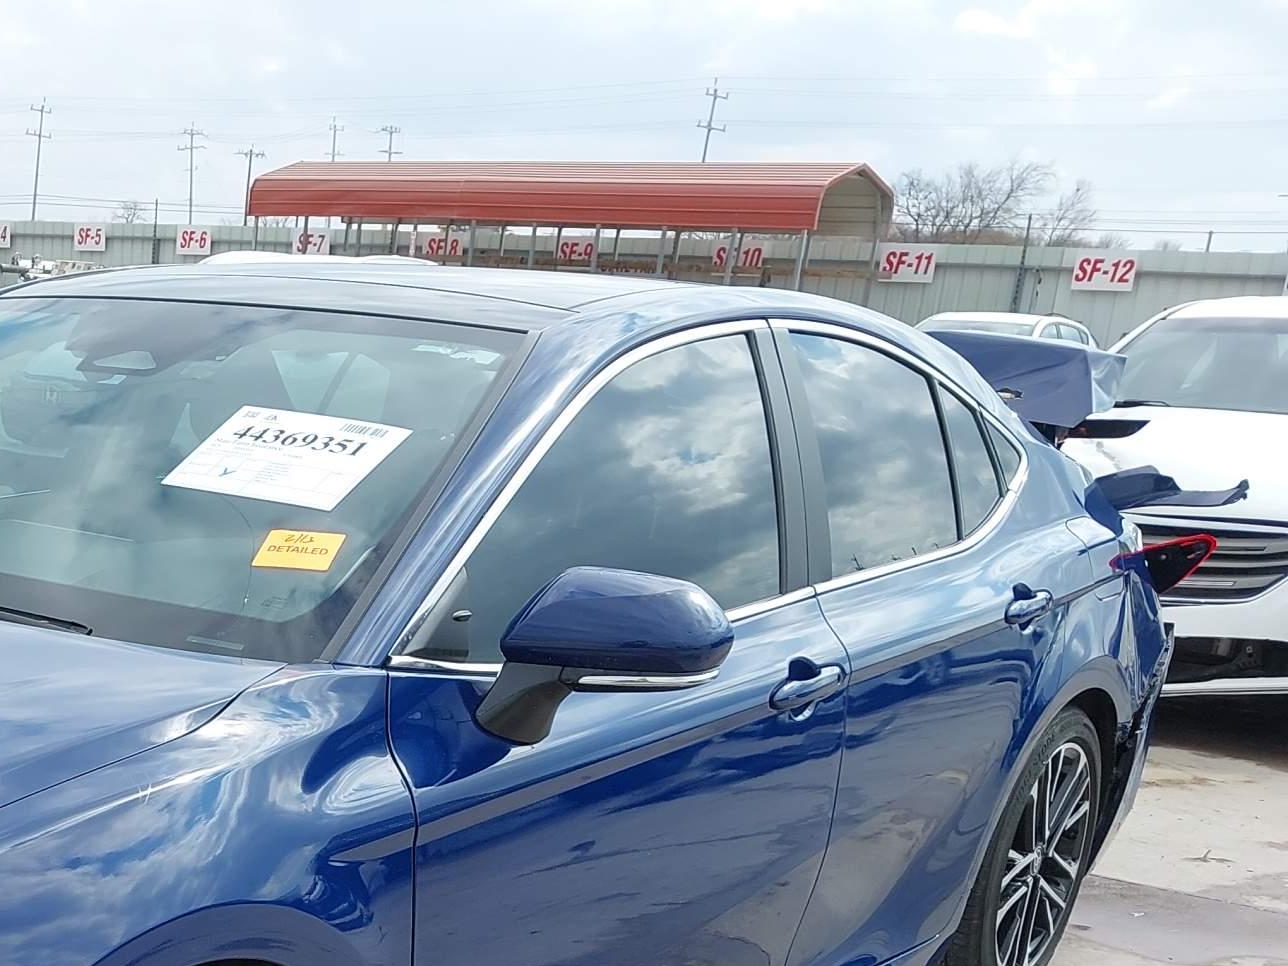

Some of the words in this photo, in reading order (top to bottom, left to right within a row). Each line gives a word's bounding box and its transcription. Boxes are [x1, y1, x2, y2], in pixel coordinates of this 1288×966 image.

[77, 228, 102, 245] SF-5
[180, 230, 208, 249] SF-6
[426, 238, 460, 256] SF8
[713, 246, 762, 266] S10
[882, 251, 934, 275] SF-11
[1074, 257, 1136, 283] SF-12
[233, 425, 369, 457] 44369351
[266, 544, 329, 556] DETAILED
